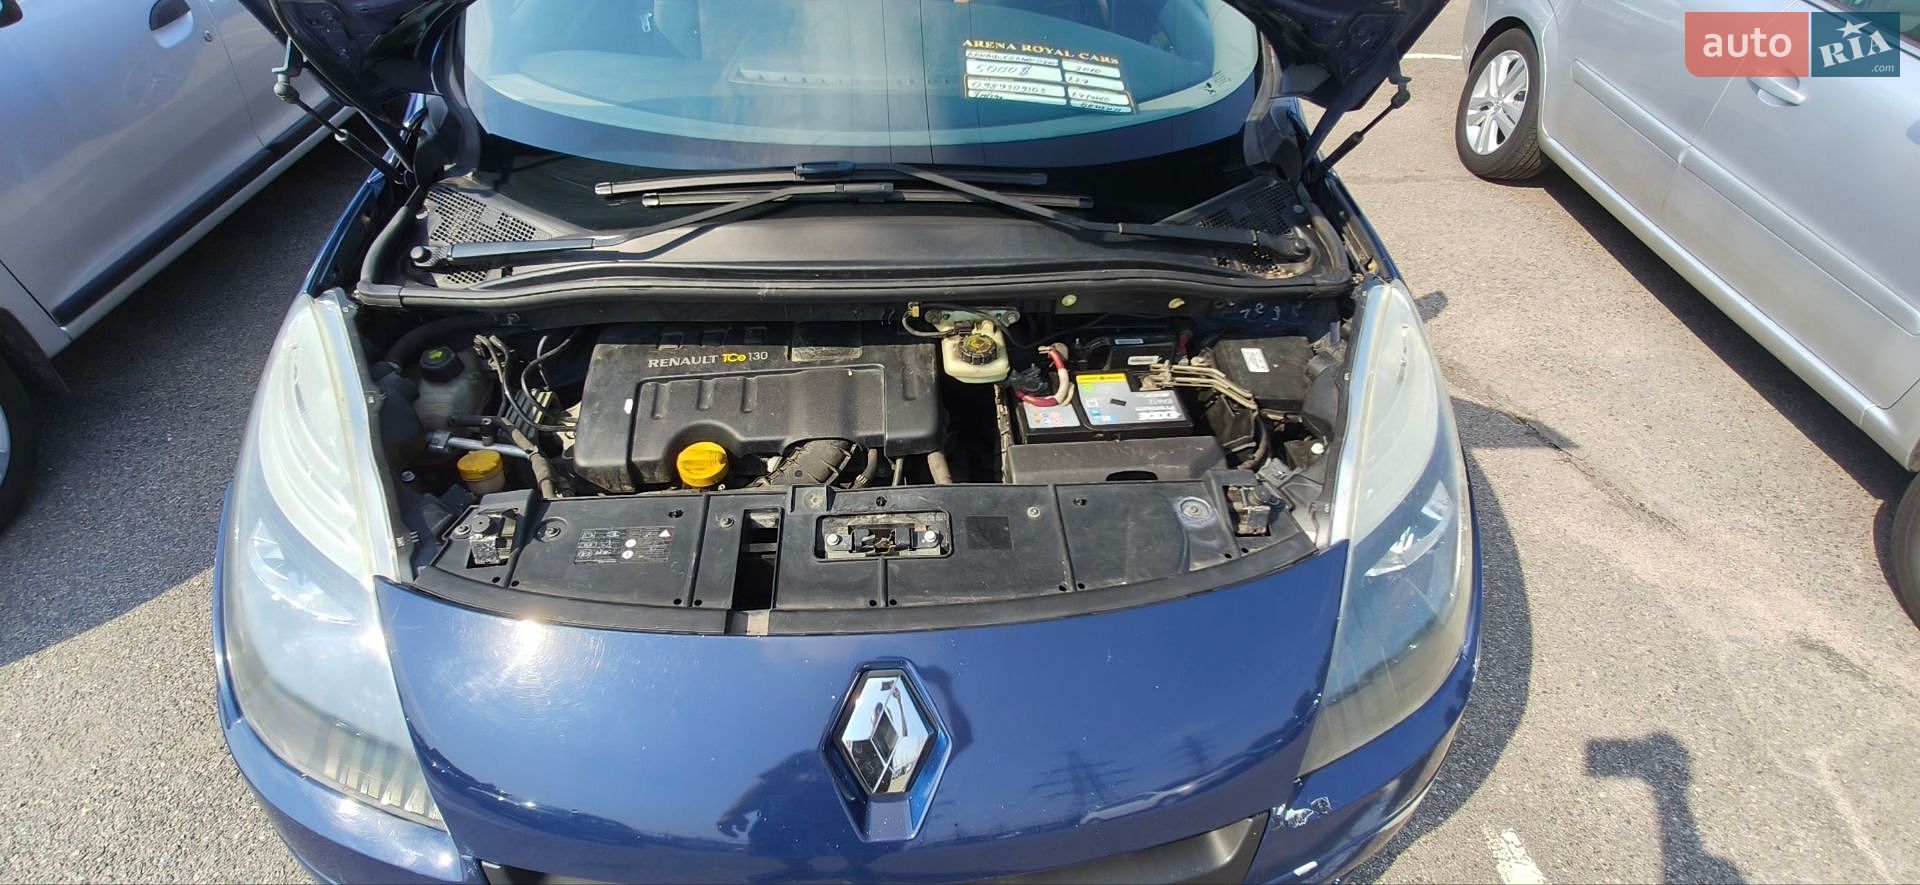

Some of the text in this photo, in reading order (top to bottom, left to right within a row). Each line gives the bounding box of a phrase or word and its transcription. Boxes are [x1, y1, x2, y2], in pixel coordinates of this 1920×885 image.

[963, 39, 1120, 64] ARENA ROYAL CARS
[648, 354, 719, 368] RENAULT
[748, 351, 769, 361] 130
